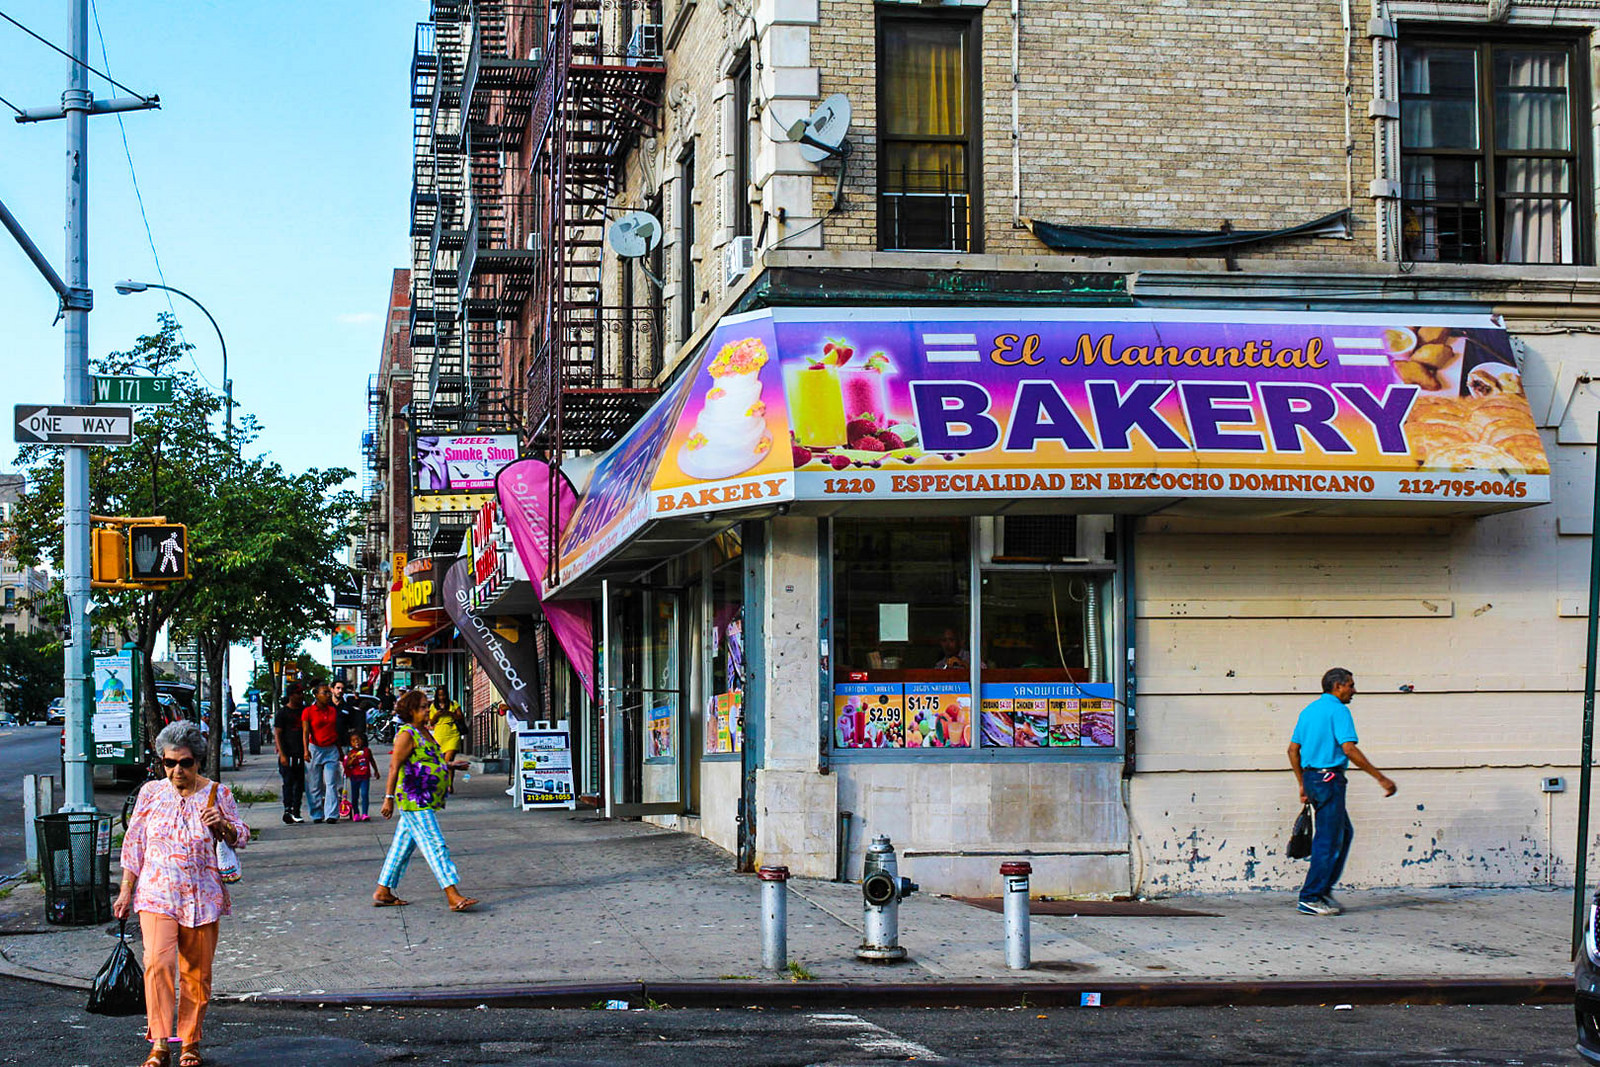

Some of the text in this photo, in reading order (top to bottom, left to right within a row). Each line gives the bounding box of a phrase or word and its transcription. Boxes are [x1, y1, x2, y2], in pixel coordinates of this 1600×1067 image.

[990, 333, 1328, 369] El Manantial
[97, 380, 167, 401] W 171 ST
[30, 417, 116, 433] ONE WAY
[908, 379, 1421, 455] BAKERY
[456, 437, 491, 445] AZEEZ
[444, 446, 516, 461] Smoke Shop
[656, 478, 788, 513] BAKERY
[823, 472, 1527, 498] 1220 ESPECIALIDAD EN BIZCOCHO DOMINICANO 212-795-0045
[561, 436, 660, 559] BAKERY
[401, 576, 433, 611] SHOP
[1013, 686, 1081, 696] SANDWICHES
[908, 696, 939, 710] $1.75
[869, 708, 901, 722] $2.99
